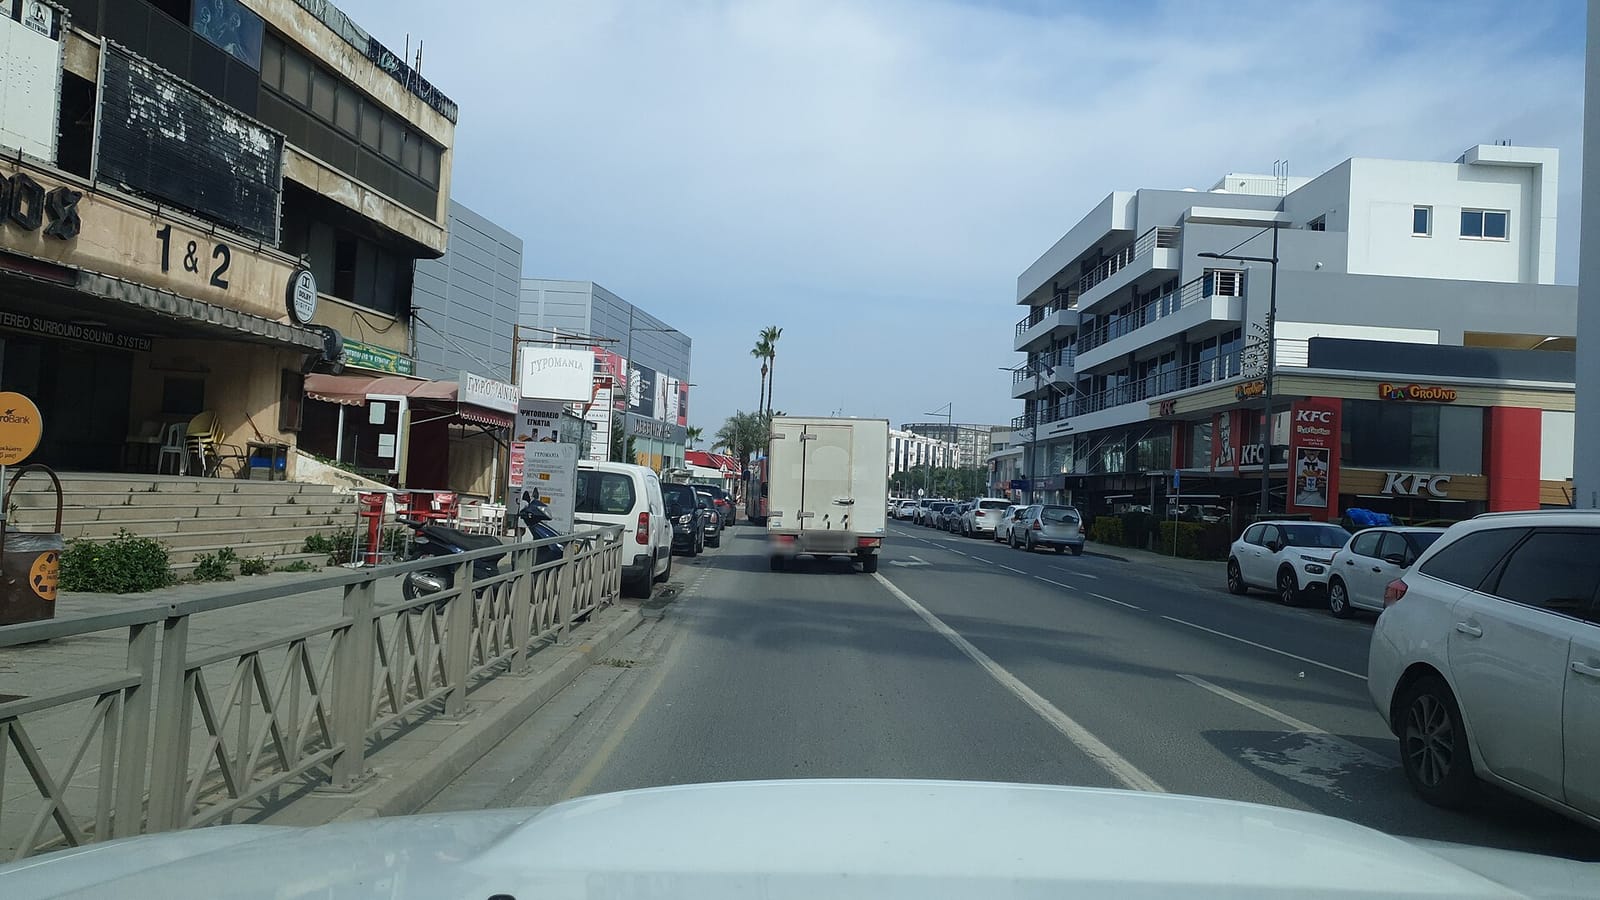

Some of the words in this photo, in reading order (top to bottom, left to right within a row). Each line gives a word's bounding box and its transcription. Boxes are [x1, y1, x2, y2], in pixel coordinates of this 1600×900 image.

[156, 224, 172, 273] 1
[183, 240, 199, 273] &
[210, 244, 232, 290] 2
[33, 318, 82, 338] SURROUND
[83, 329, 114, 344] SOUND
[117, 334, 151, 351] SYSTEM
[1409, 386, 1458, 400] GROUND
[1159, 400, 1176, 416] KFC
[1295, 409, 1331, 424] KFC
[527, 418, 550, 427] ΕΓΝΑΤΙΑ
[1241, 443, 1264, 465] KFC
[1381, 472, 1452, 497] KFC
